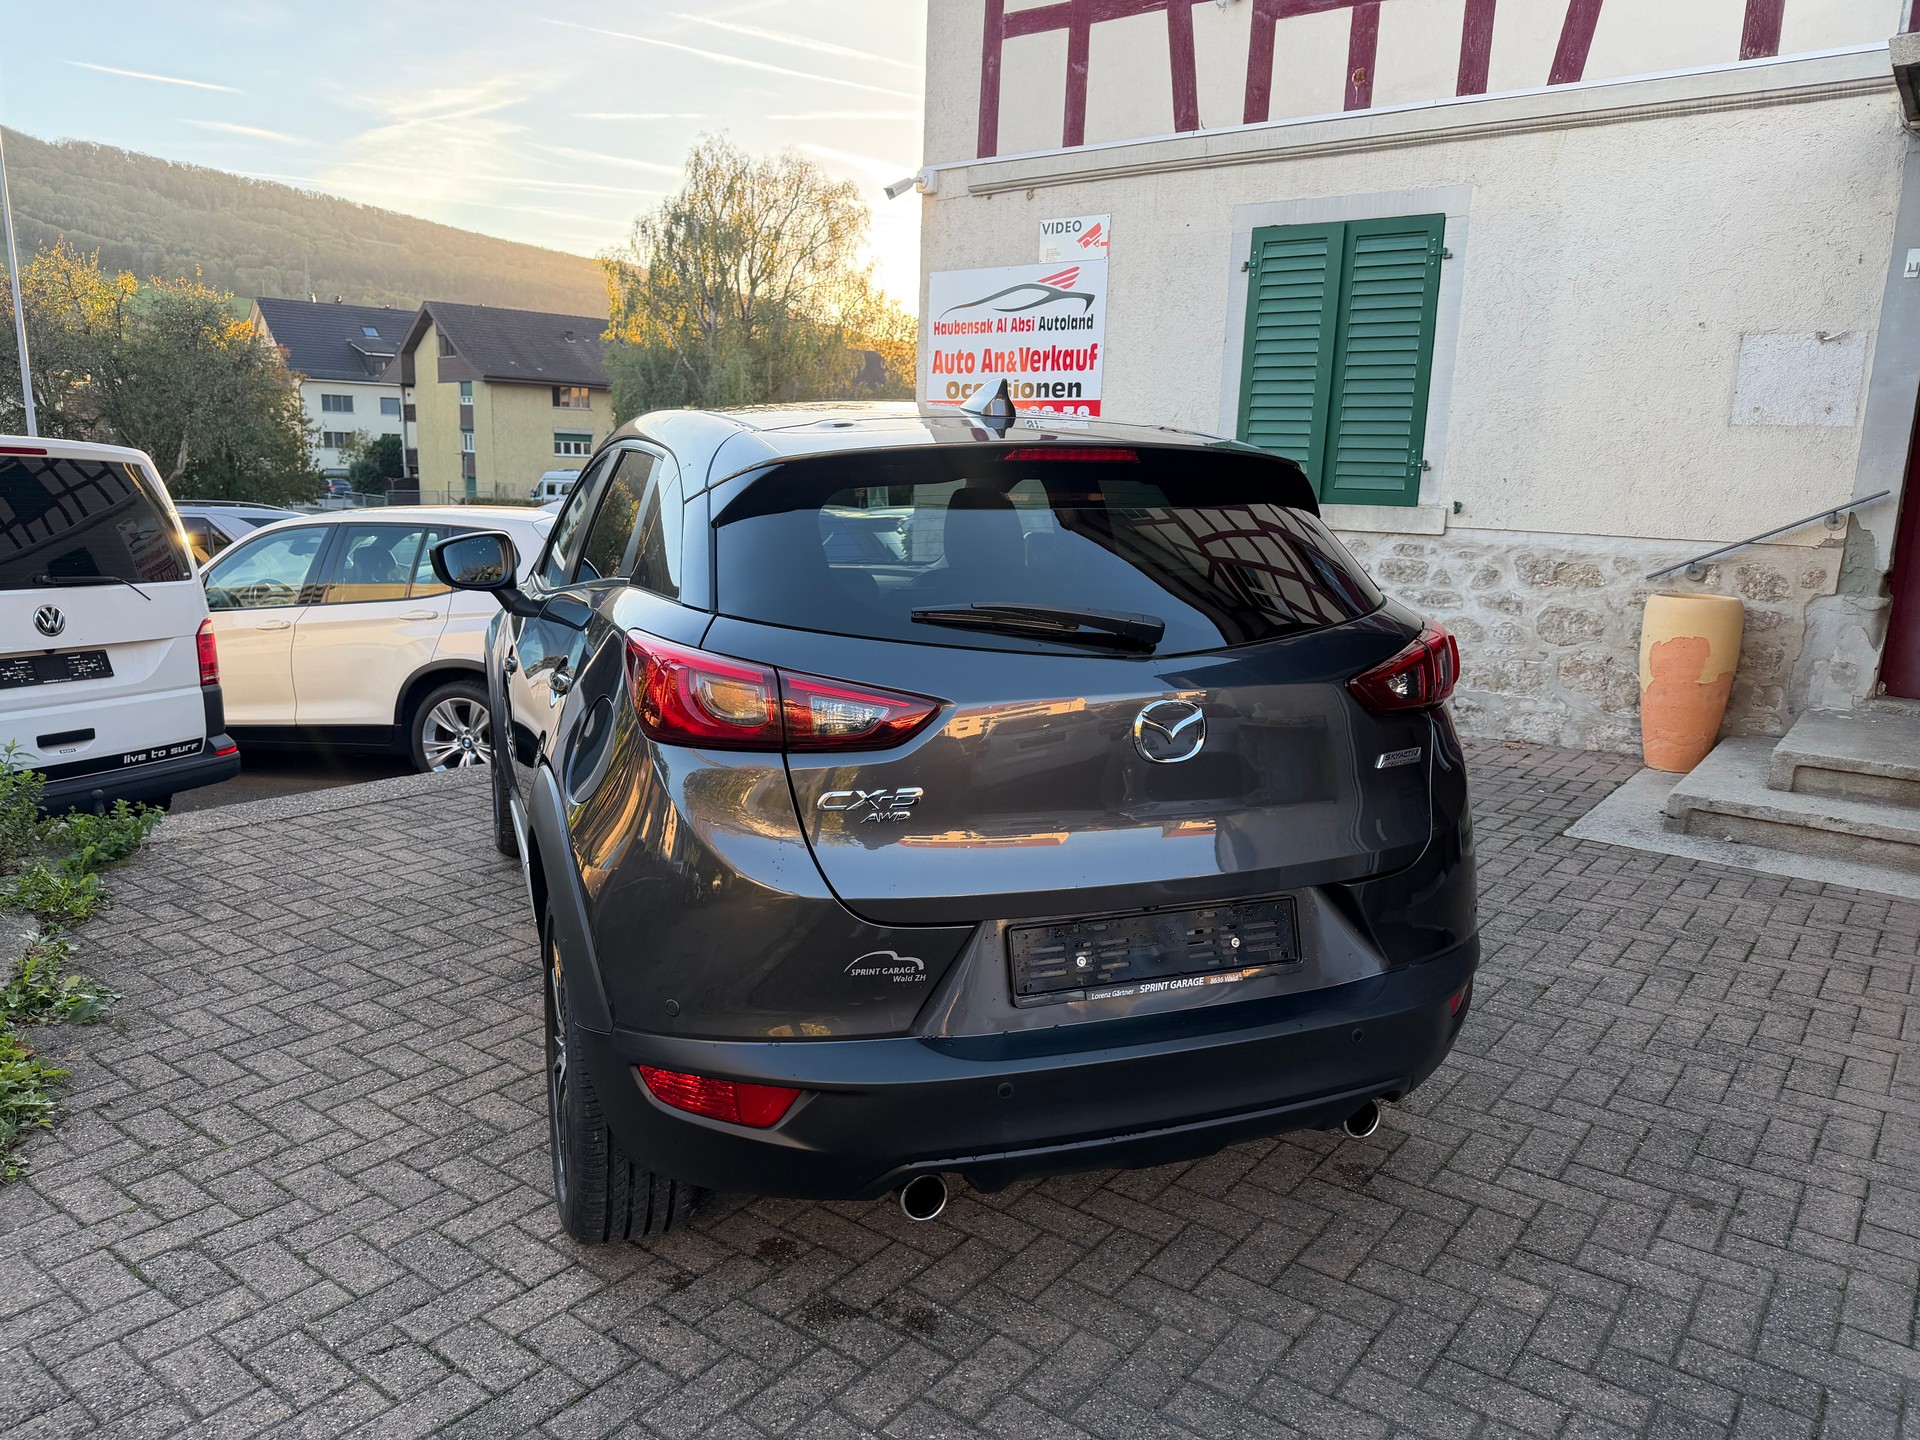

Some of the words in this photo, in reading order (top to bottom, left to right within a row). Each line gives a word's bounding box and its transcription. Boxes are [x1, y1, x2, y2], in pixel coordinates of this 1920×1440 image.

[1042, 220, 1082, 235] VIDEO
[933, 319, 993, 336] Haubensak
[996, 318, 1007, 333] Al
[1010, 316, 1035, 332] Absi
[1038, 314, 1094, 331] Autoland
[932, 349, 976, 374] Auto
[981, 343, 1098, 373] An&Verkauf
[123, 754, 147, 764] live
[151, 749, 166, 758] to
[170, 742, 199, 754] surf
[817, 787, 923, 811] CX-3
[860, 811, 911, 824] AWD
[851, 968, 880, 976] SPRINT
[882, 966, 916, 975] GARAGE
[915, 974, 926, 982] ZH
[1091, 992, 1111, 1000] Lorenz
[1139, 981, 1169, 993] SPRINT
[1170, 977, 1204, 989] GARAGE
[1224, 974, 1239, 983] Wald
